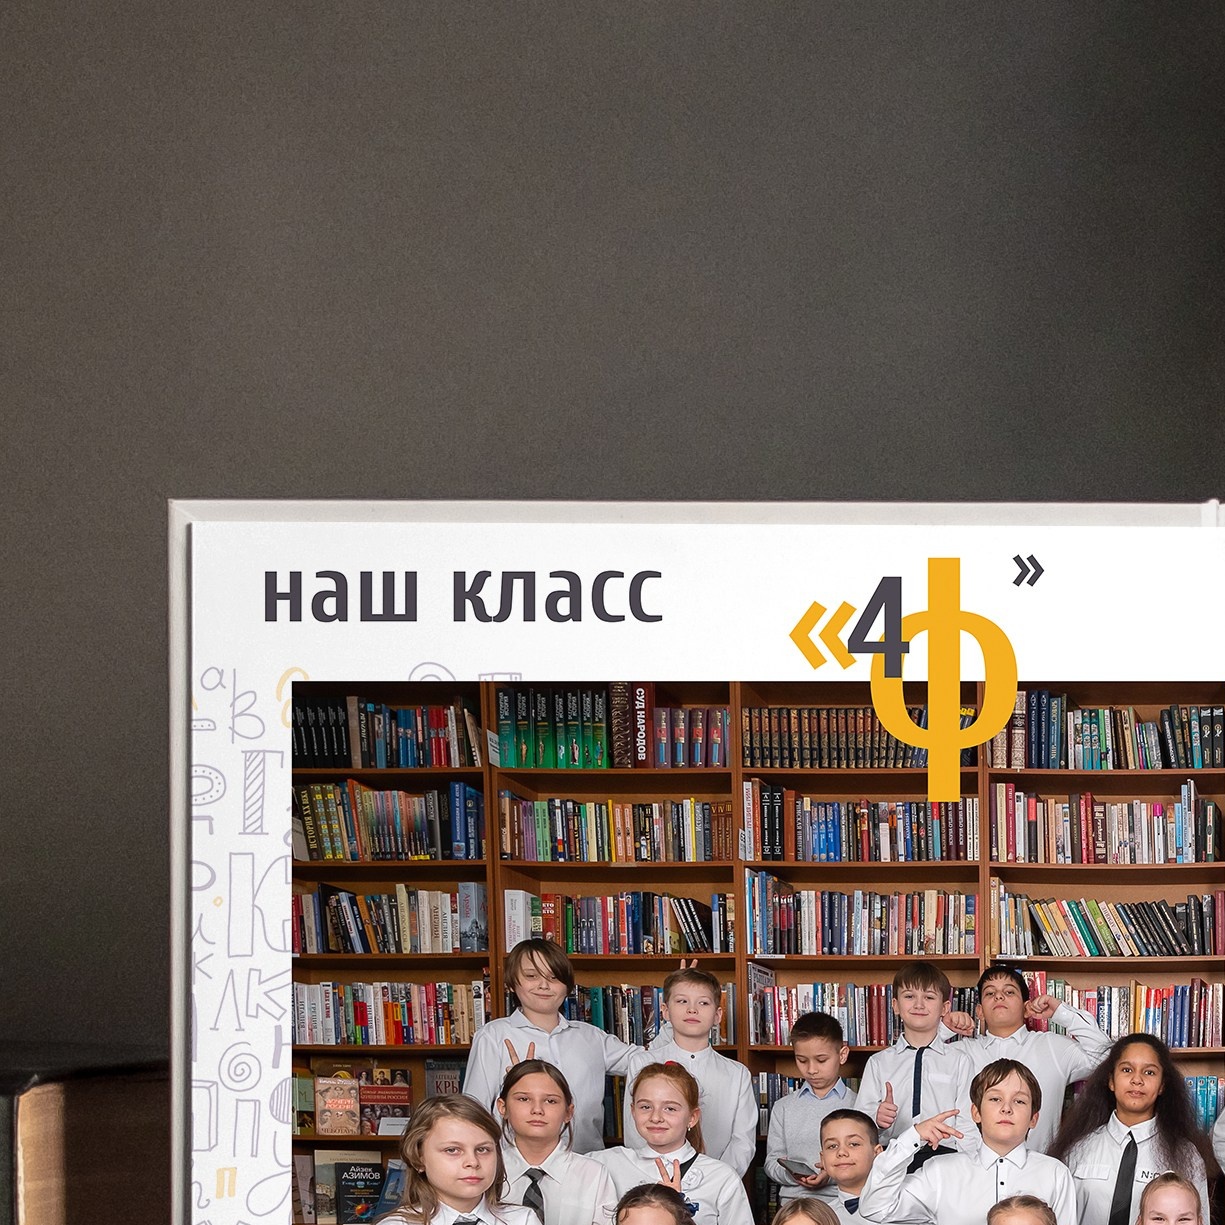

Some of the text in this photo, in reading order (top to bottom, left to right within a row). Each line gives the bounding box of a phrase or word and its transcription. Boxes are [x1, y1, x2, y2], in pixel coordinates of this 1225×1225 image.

[265, 571, 662, 622] наш класс
[636, 687, 646, 760] СУД НАРОДОВ
[305, 816, 317, 848] ИСТОРИЯ
[399, 901, 407, 942] АНГЛОСАКСЫ
[342, 1172, 381, 1180] АЗИМОВ
